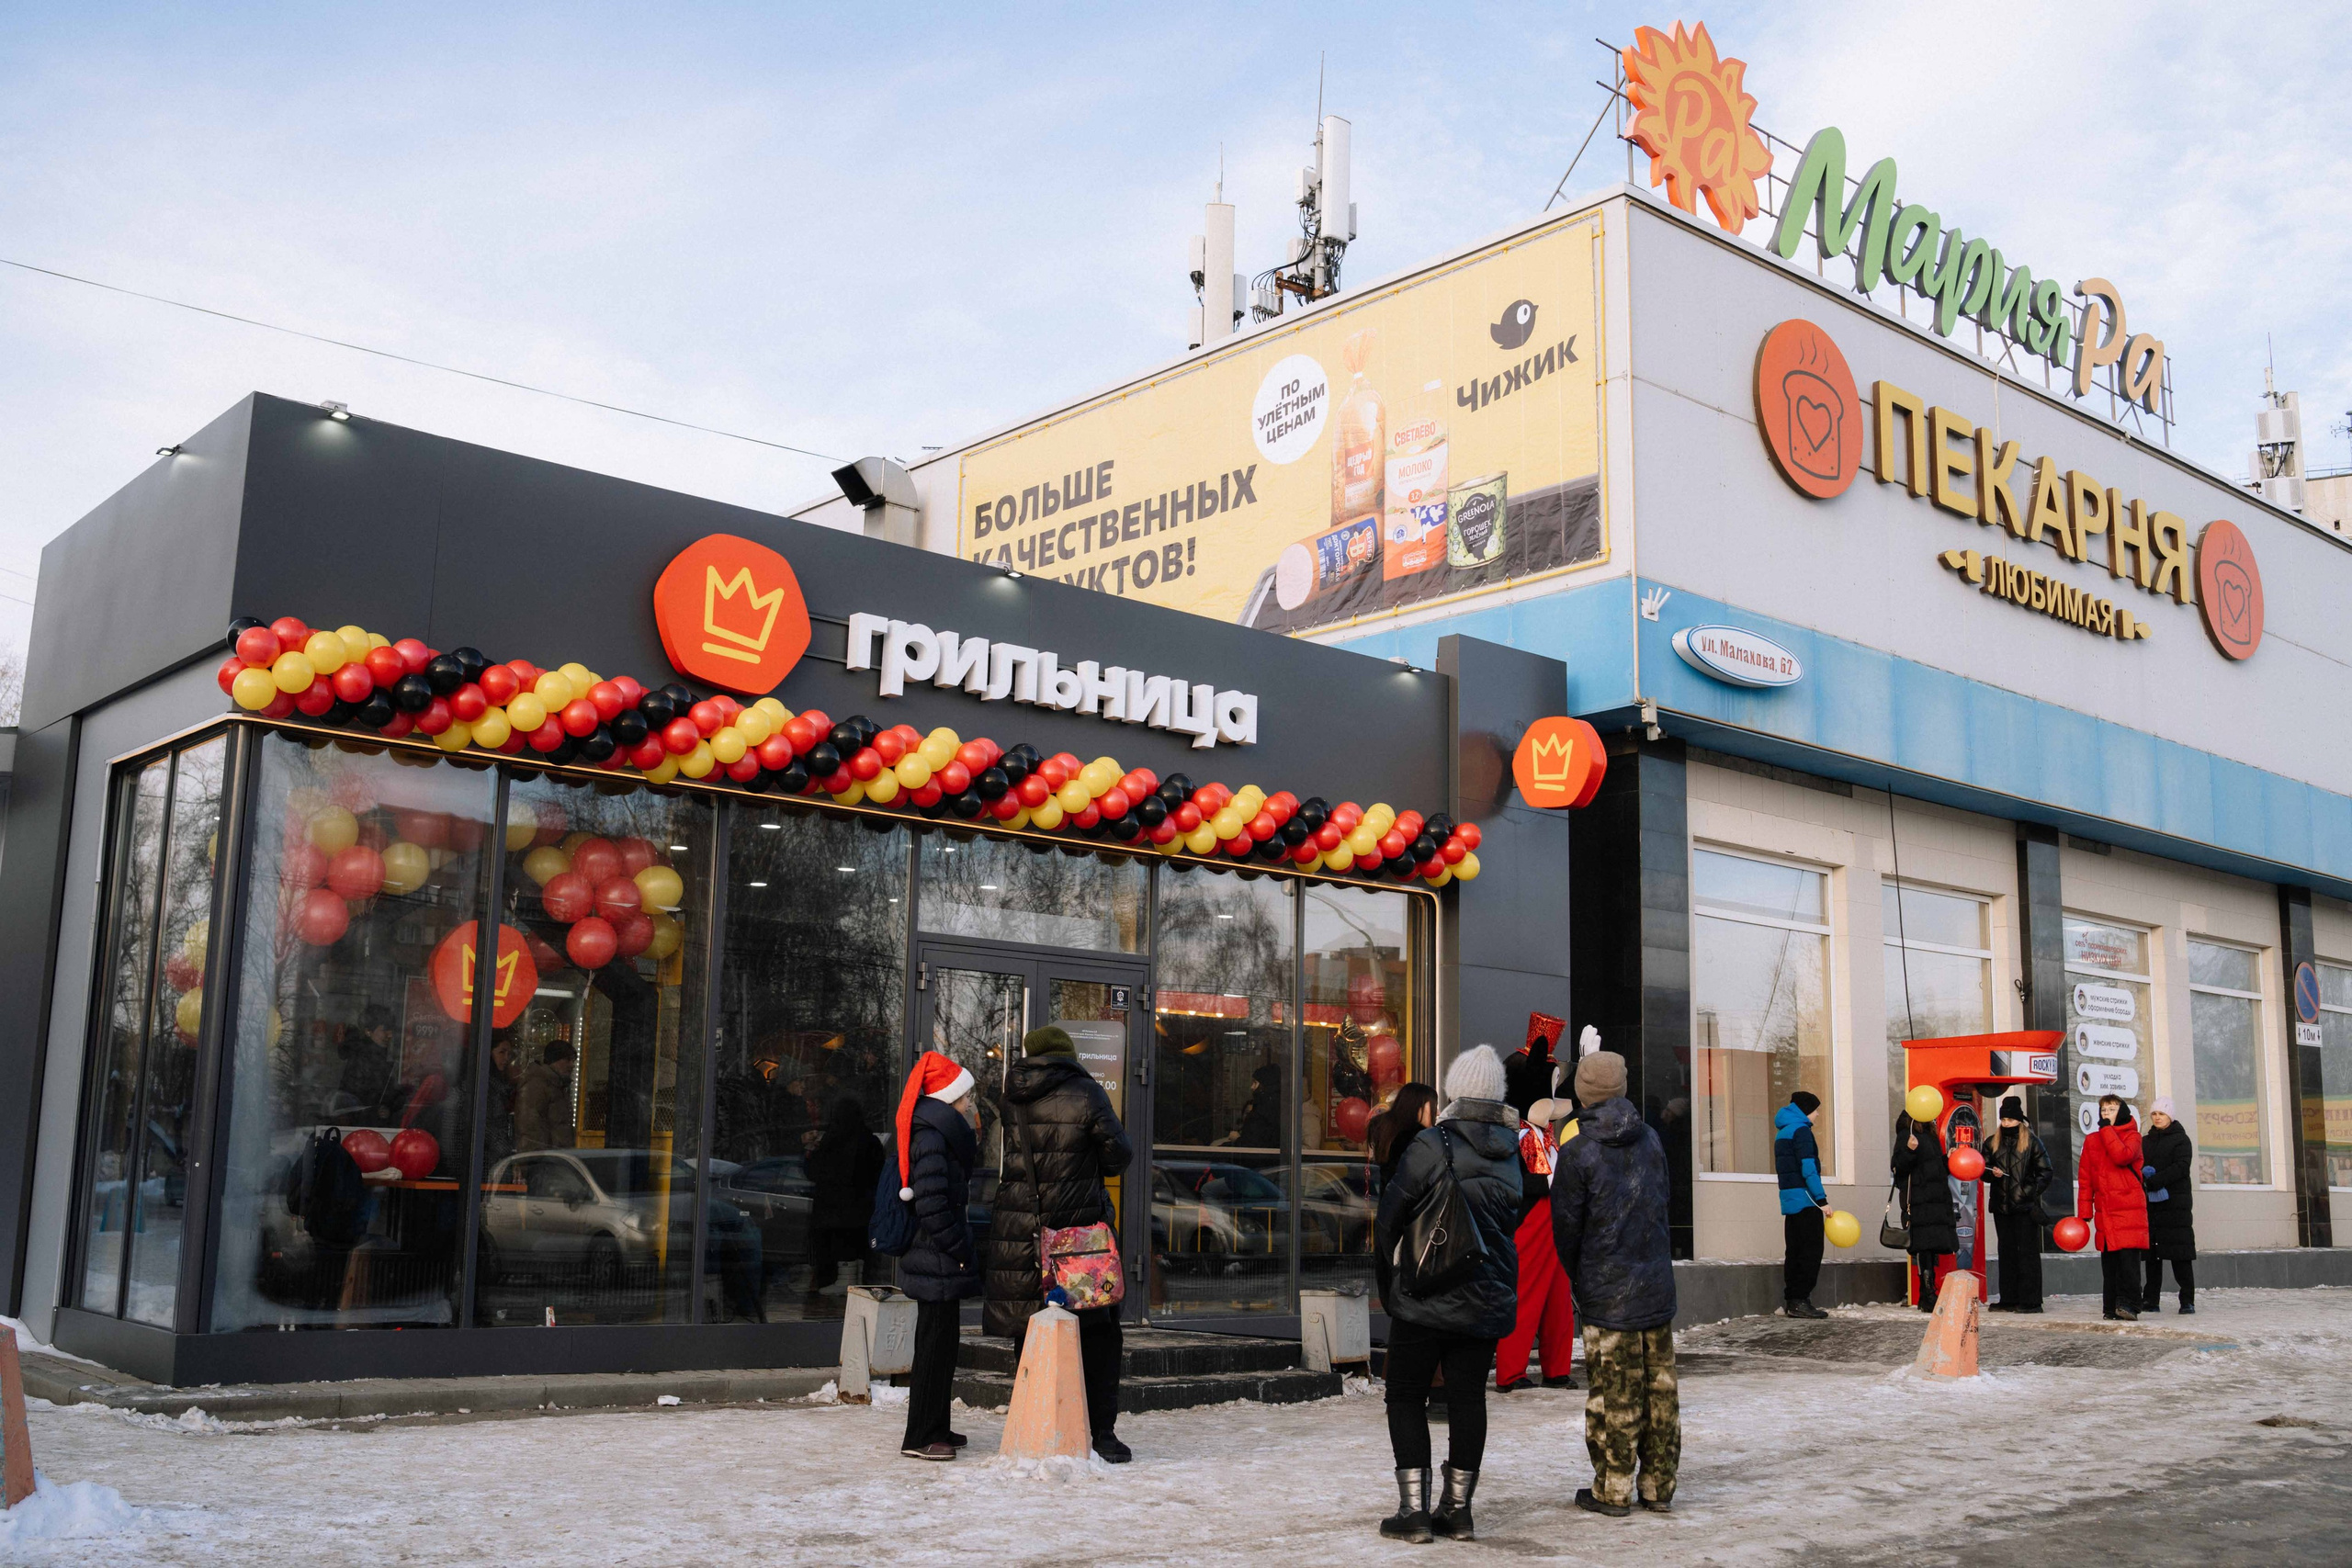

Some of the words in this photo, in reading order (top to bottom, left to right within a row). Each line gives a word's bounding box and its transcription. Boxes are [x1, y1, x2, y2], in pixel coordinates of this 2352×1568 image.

[1770, 126, 2070, 368] Мария
[2072, 277, 2165, 414] Ра
[1257, 382, 1325, 431] УЛЁТНЫМ
[1281, 378, 1300, 400] ПО
[1266, 406, 1316, 444] ЦЕНАМ
[1398, 458, 1432, 479] МОЛОКО
[974, 459, 1114, 539] БОЛЬШЕ
[1871, 379, 2191, 605] ПЕКАРНЯ
[1457, 500, 1495, 524] GREENOLA
[1463, 519, 1492, 536] ГОРОШЕК
[1980, 555, 2116, 637] ЛЮБИМАЯ
[1720, 638, 1778, 673] Малахова,
[1781, 657, 1793, 675] 62
[846, 612, 1259, 750] грильница
[1079, 1052, 1117, 1061] грильница
[2033, 1059, 2052, 1073] ROCKY
